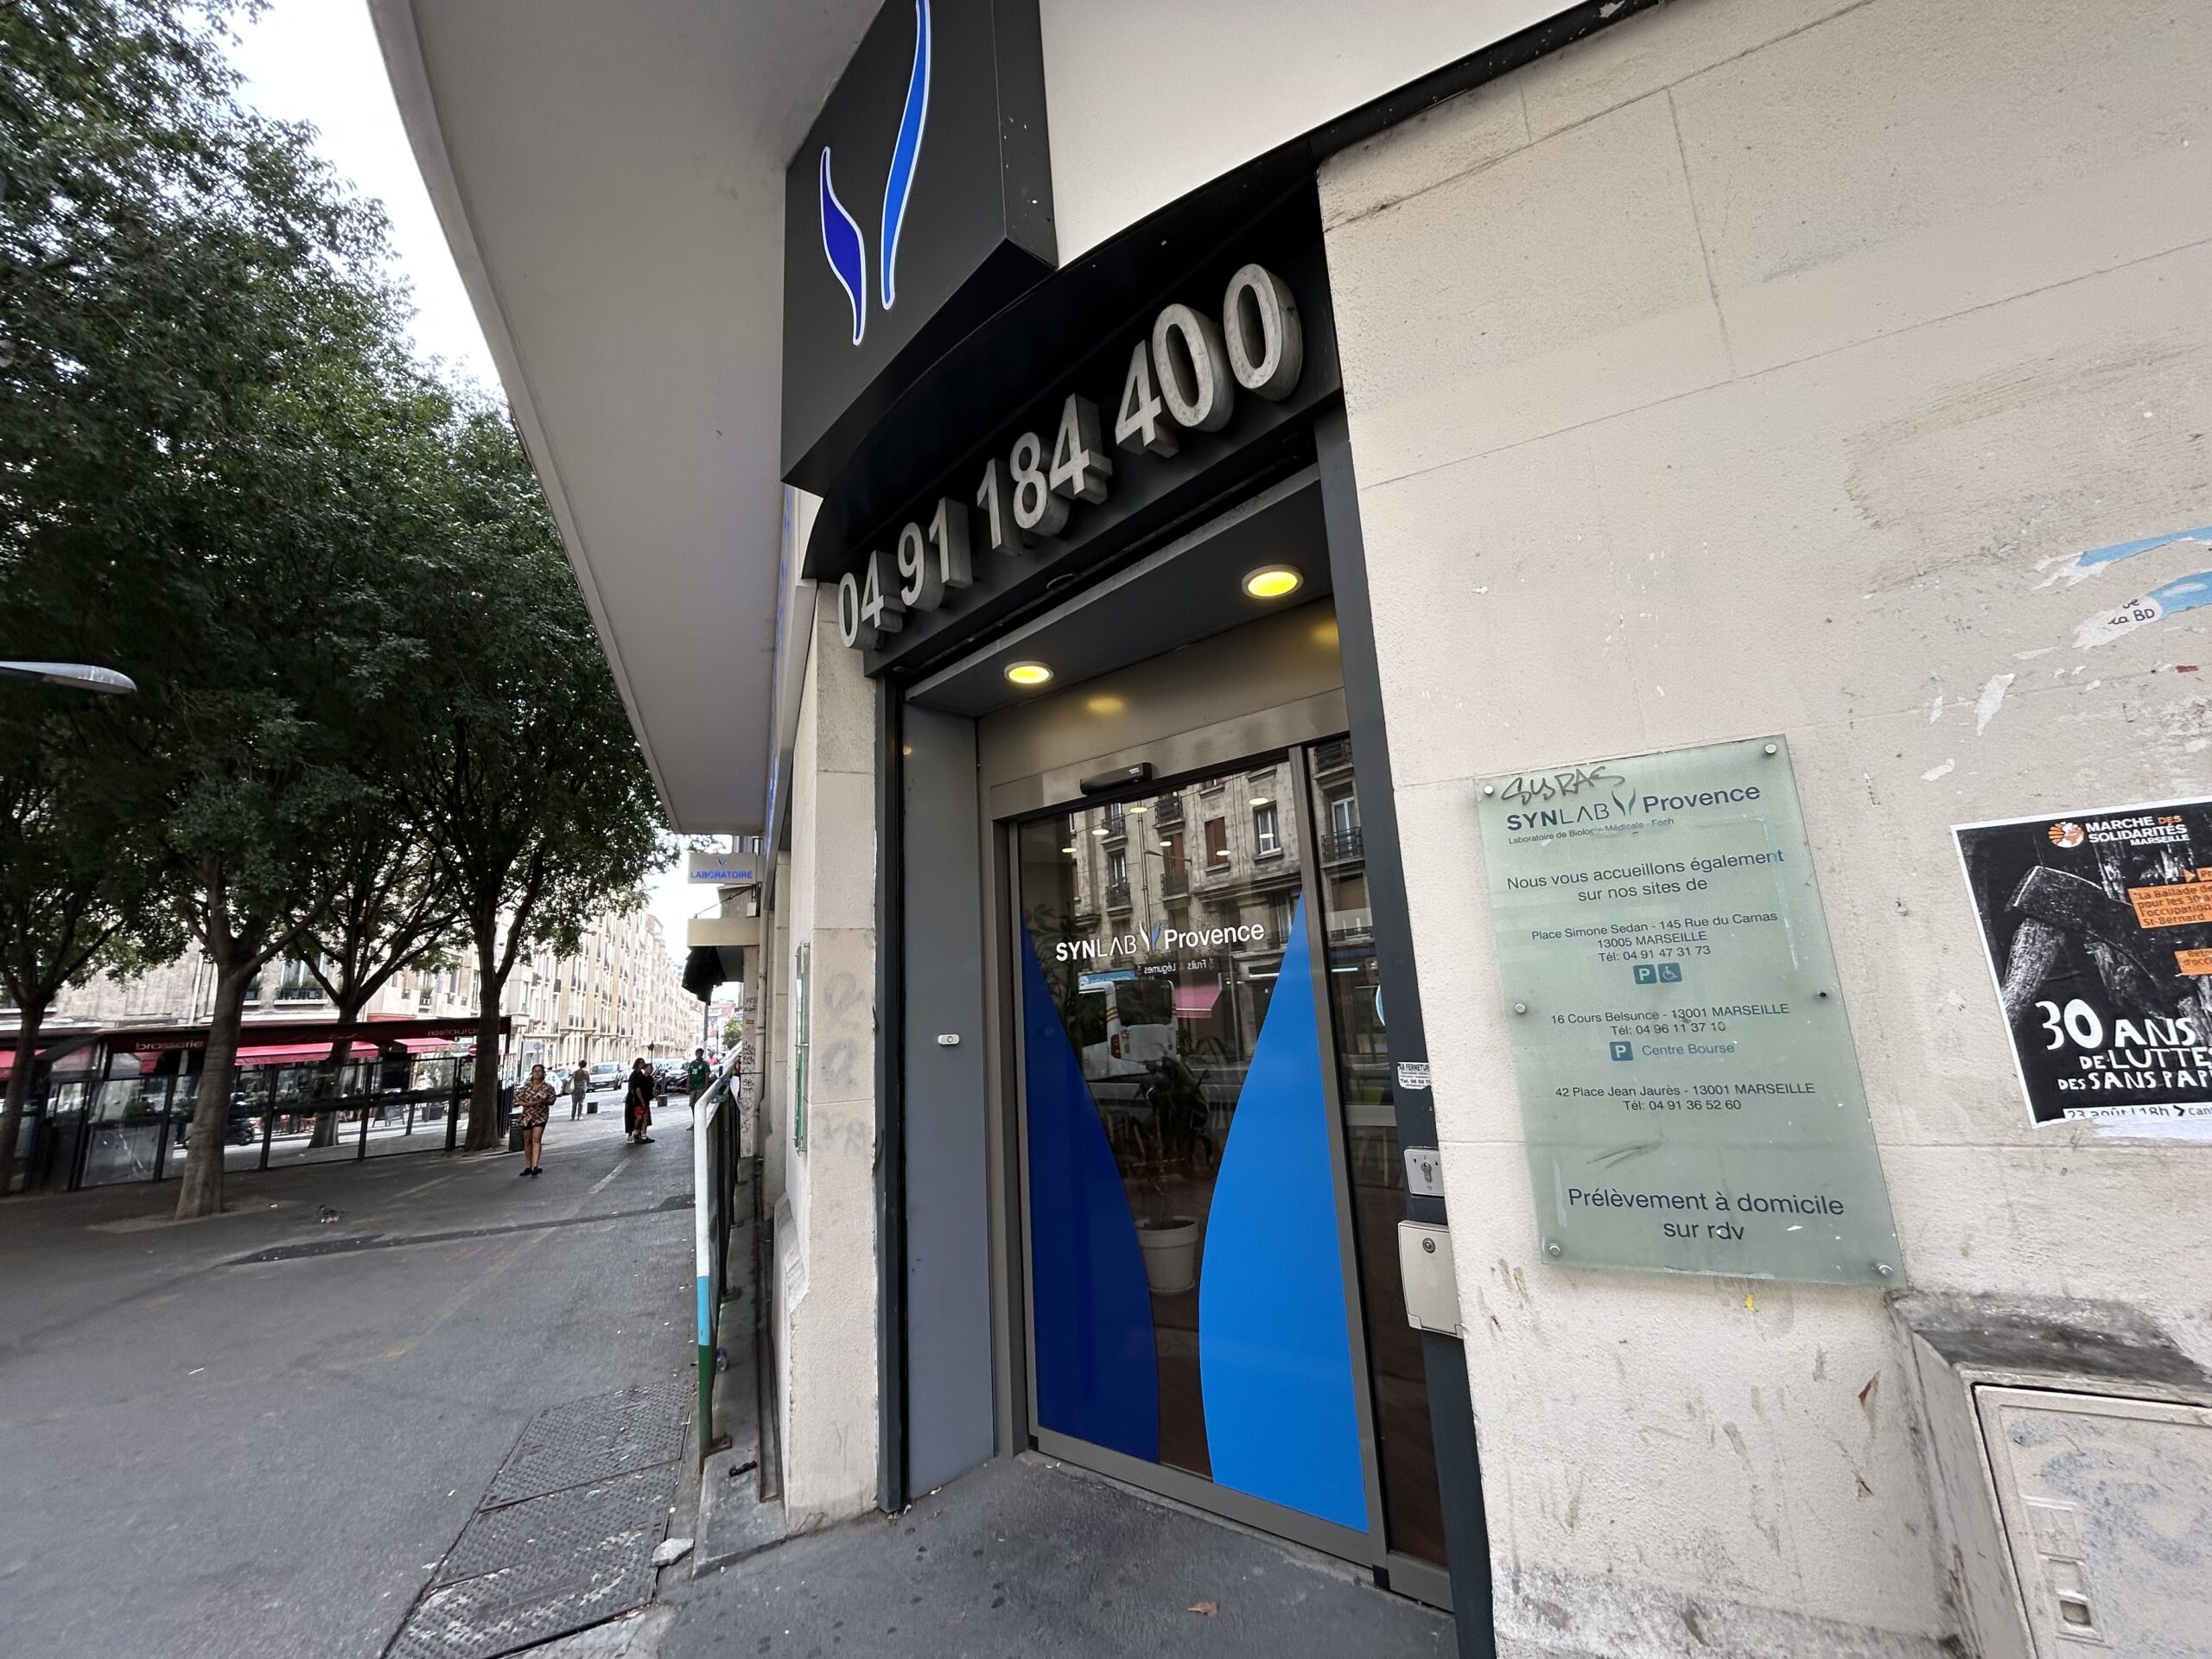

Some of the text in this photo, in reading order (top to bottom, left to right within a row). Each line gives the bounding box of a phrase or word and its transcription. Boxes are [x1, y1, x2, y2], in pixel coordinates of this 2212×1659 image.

[838, 263, 1299, 649] 04 91 184 400
[2133, 608, 2155, 621] BD
[1507, 784, 1761, 831] SYNLAB Provence
[2085, 815, 2183, 832] MARCHE DES
[1509, 832, 1554, 844] Laboratoire
[1556, 829, 1567, 839] de
[2088, 823, 2188, 843] SOLIDARITÉS
[2131, 834, 2190, 846] MARSEILLE
[690, 870, 753, 879] LABORATOIRE
[1507, 849, 1784, 891] Nous vous accueillons également
[1578, 877, 1707, 901] sur nos sites de
[2154, 887, 2198, 899] Ballade
[2138, 899, 2165, 909] pour
[2167, 897, 2184, 906] les
[2186, 895, 2200, 904] 30
[1532, 931, 1562, 940] Place
[1565, 927, 1608, 938] Simone
[1611, 923, 1649, 934] Sedan
[1659, 919, 1681, 930] 145
[1684, 918, 1709, 928] Rue
[1713, 916, 1729, 926] du
[1732, 912, 1778, 924] Camas
[2143, 913, 2205, 926] St-Bernard
[1056, 923, 1265, 962] SYNLAB Provence
[1598, 931, 1708, 949] 13005 MARSEILLE
[1598, 945, 1711, 963] Tél: 04 91 47 31 73
[1638, 968, 1650, 981] P
[1551, 1014, 1565, 1024] 16
[1567, 1014, 1602, 1023] Cours
[1605, 1011, 1659, 1021] Belsunce
[1671, 1007, 1707, 1019] 13001
[1712, 1003, 1790, 1017] MARSEILLE
[1611, 1021, 1726, 1035] Tél: 04 96 11 37 10
[2035, 998, 2196, 1051] 30 ANS
[1642, 1045, 1684, 1056] Centre
[1688, 1043, 1735, 1054] Bourse
[2079, 1055, 2107, 1070] DE
[2057, 1078, 2086, 1090] DES
[2088, 1071, 2157, 1090] SANS
[1555, 1087, 1570, 1097] 42
[1573, 1086, 1605, 1097] Place
[1608, 1086, 1636, 1096] Jean
[1640, 1084, 1681, 1096] Jaurès
[1693, 1084, 1730, 1096] 13001
[1734, 1083, 1816, 1095] MARSEILLE
[1623, 1099, 1741, 1110] Tél: 04 91 36 52 60
[1567, 1187, 1845, 1216] Prélèvement à domicile
[1663, 1221, 1745, 1241] sur rdv
